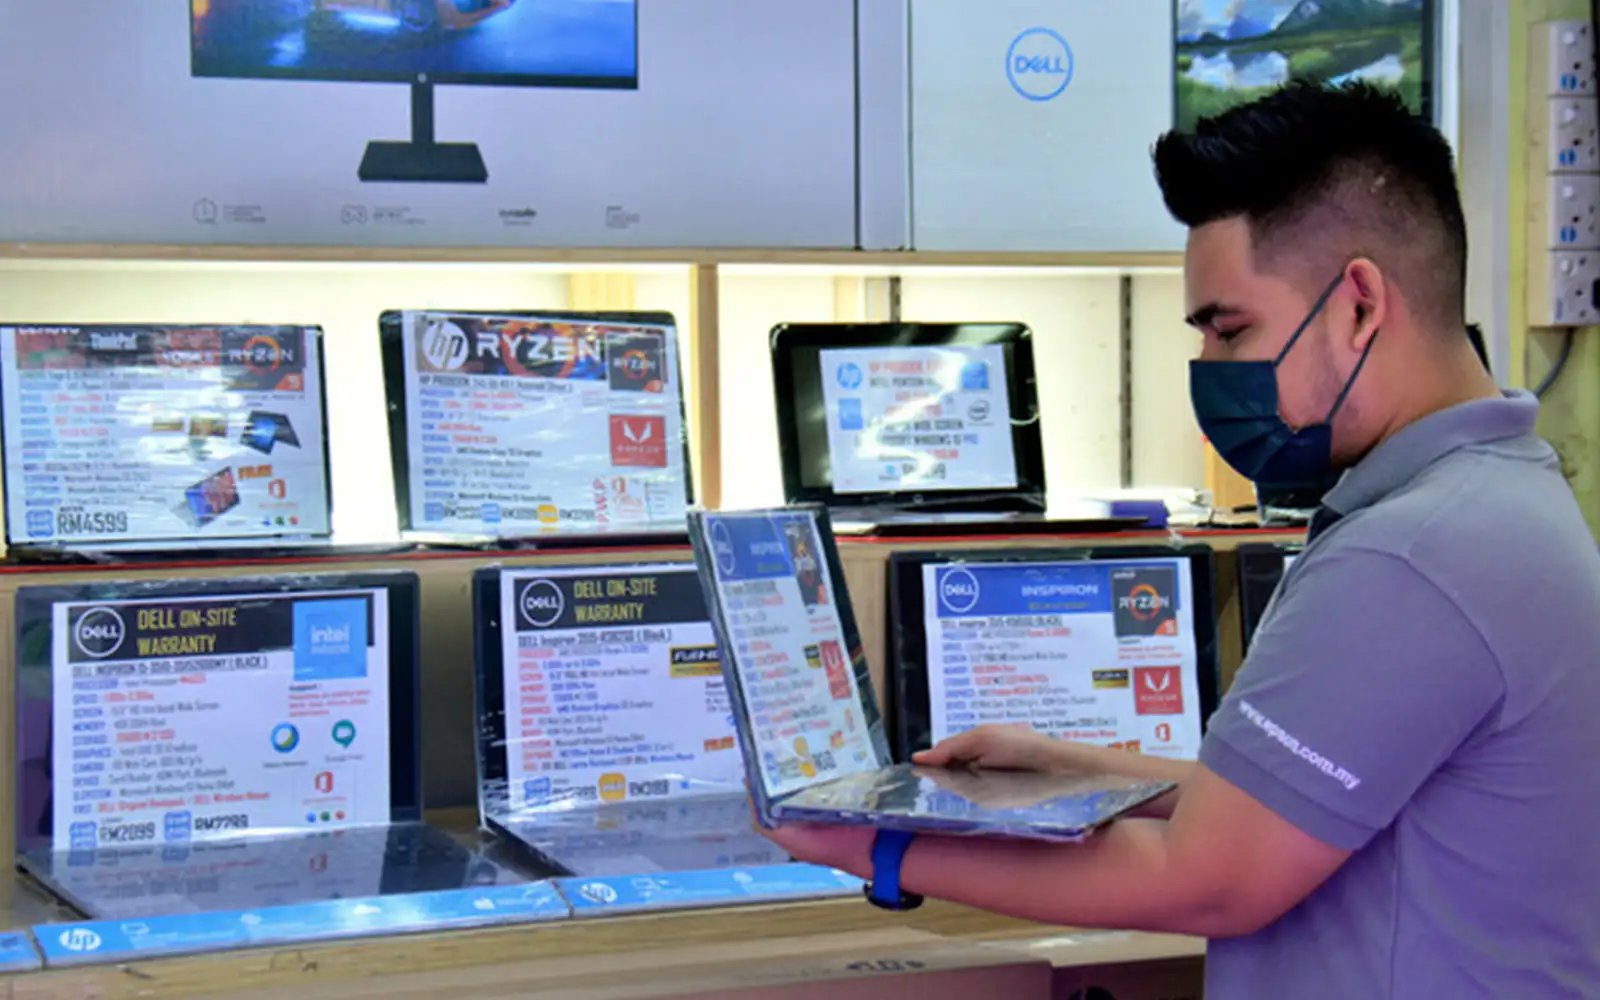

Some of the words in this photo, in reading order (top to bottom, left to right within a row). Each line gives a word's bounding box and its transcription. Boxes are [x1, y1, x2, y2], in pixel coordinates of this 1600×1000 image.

[1014, 55, 1066, 73] DELL
[476, 333, 601, 362] RYZEN
[57, 512, 128, 535] RM4599
[573, 581, 603, 599] DELL
[606, 578, 657, 597] ON-SITE
[945, 583, 976, 596] DELL
[1021, 584, 1099, 597] INSPIRON
[526, 597, 559, 609] DELL
[1119, 595, 1170, 609] RYZEN
[137, 609, 175, 629] DELL
[179, 607, 237, 627] ON-SITE
[574, 603, 645, 622] WARRANTY
[82, 626, 118, 640] DELL
[137, 634, 217, 656] WARRANTY
